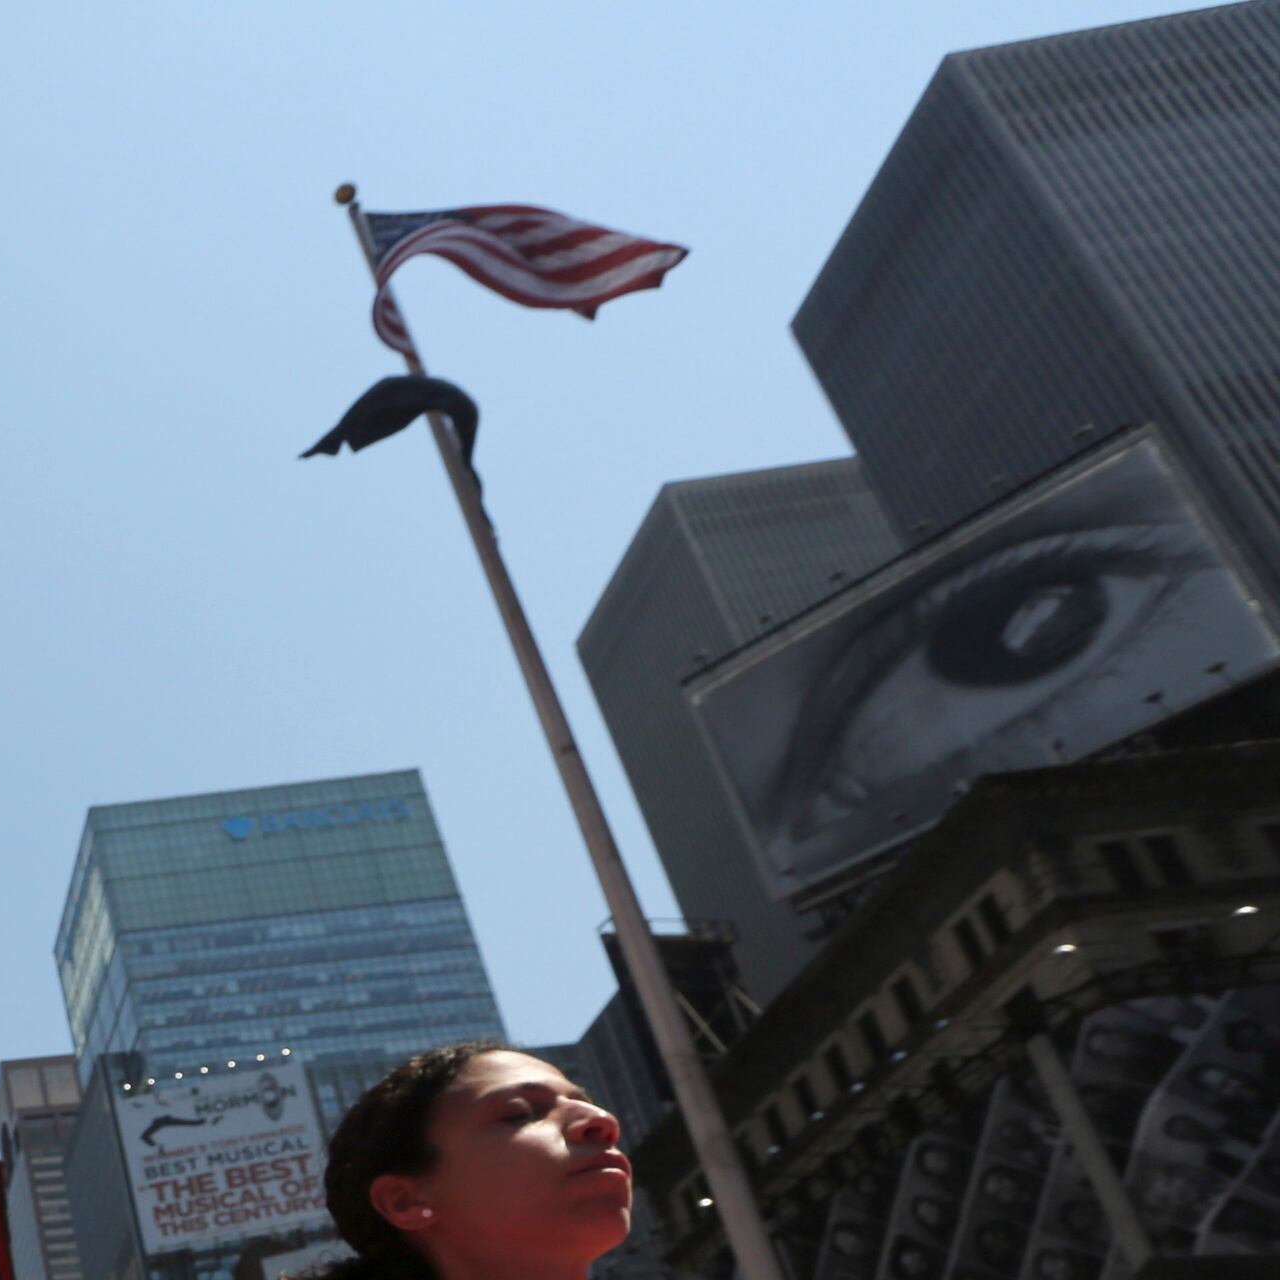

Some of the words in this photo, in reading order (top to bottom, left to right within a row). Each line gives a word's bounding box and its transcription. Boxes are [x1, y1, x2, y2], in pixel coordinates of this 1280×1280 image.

[145, 1156, 199, 1181] BEST
[206, 1138, 308, 1167] MUSICAL
[225, 1152, 313, 1190] BEST
[153, 1186, 276, 1222] MUSICAL
[280, 1175, 320, 1198] OF
[159, 1215, 209, 1238] THIS
